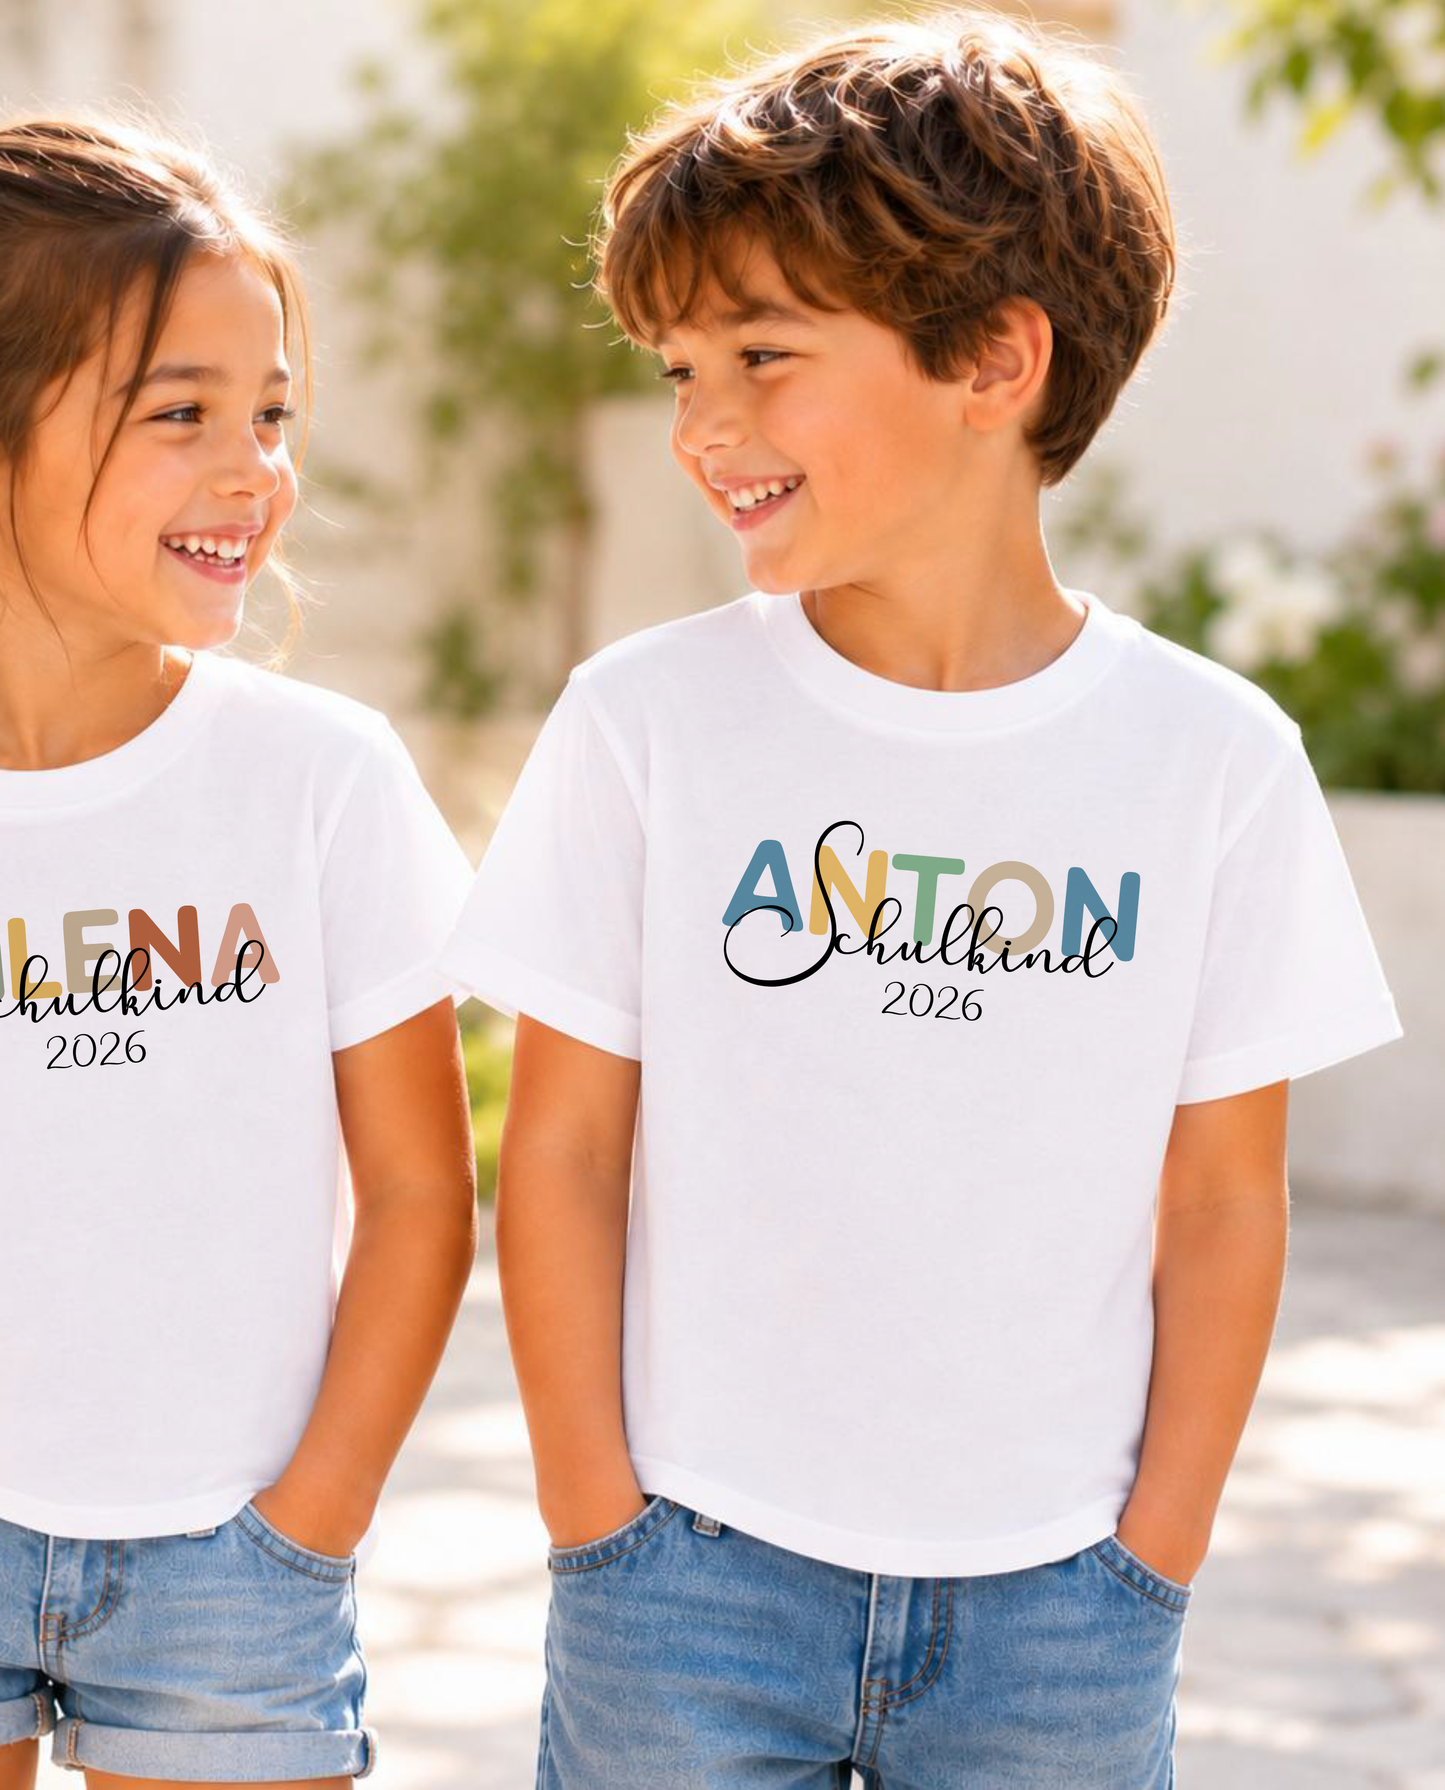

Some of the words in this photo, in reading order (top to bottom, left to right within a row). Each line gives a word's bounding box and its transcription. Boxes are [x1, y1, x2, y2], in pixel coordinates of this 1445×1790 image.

[722, 839, 1141, 962] ANTON
[724, 820, 1118, 987] Schulkind
[0, 903, 281, 1001] LENA
[46, 1030, 147, 1070] 2026
[881, 981, 985, 1022] 2026
